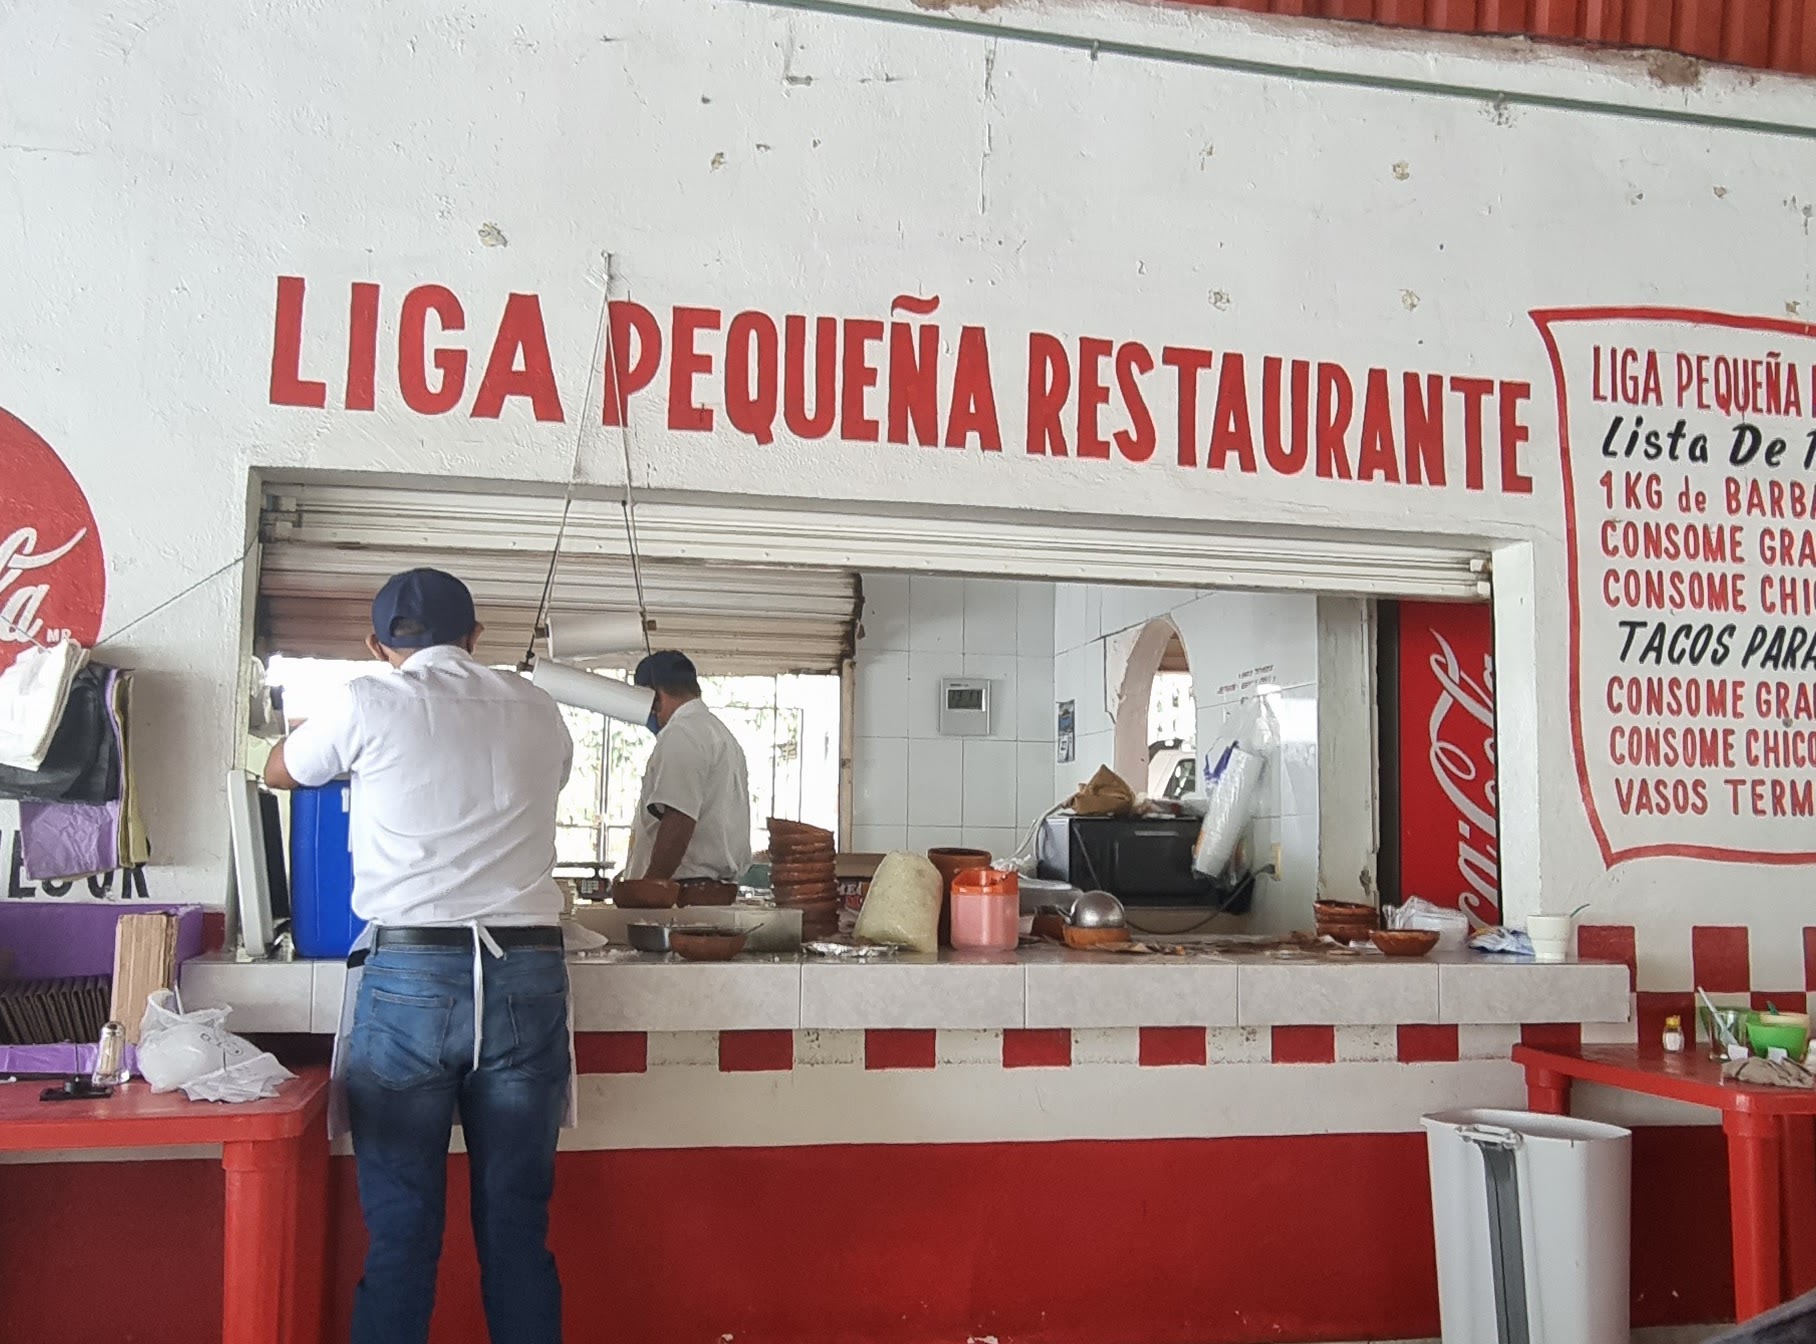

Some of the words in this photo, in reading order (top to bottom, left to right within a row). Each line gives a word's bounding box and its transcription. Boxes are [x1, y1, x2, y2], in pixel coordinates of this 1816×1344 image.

[270, 276, 565, 423] LIGA
[602, 294, 1002, 452] PEQUEÑA
[1026, 332, 1533, 494] RESTAURANTE
[1593, 344, 1663, 406] LIGA
[1676, 351, 1802, 417] PEQUEÑA
[1602, 415, 1708, 463] Lista
[1729, 421, 1787, 468] De
[1678, 475, 1706, 514] de
[1601, 520, 1745, 563] CONSOME
[1603, 568, 1747, 613] CONSOME
[1760, 574, 1816, 615] CHI
[1618, 620, 1737, 666] TACOS
[1607, 675, 1745, 719] CONSOME
[1756, 681, 1816, 721] GRA
[1610, 725, 1736, 768] CONSOME
[1615, 777, 1708, 815] VASOS
[1724, 778, 1815, 817] TERM
